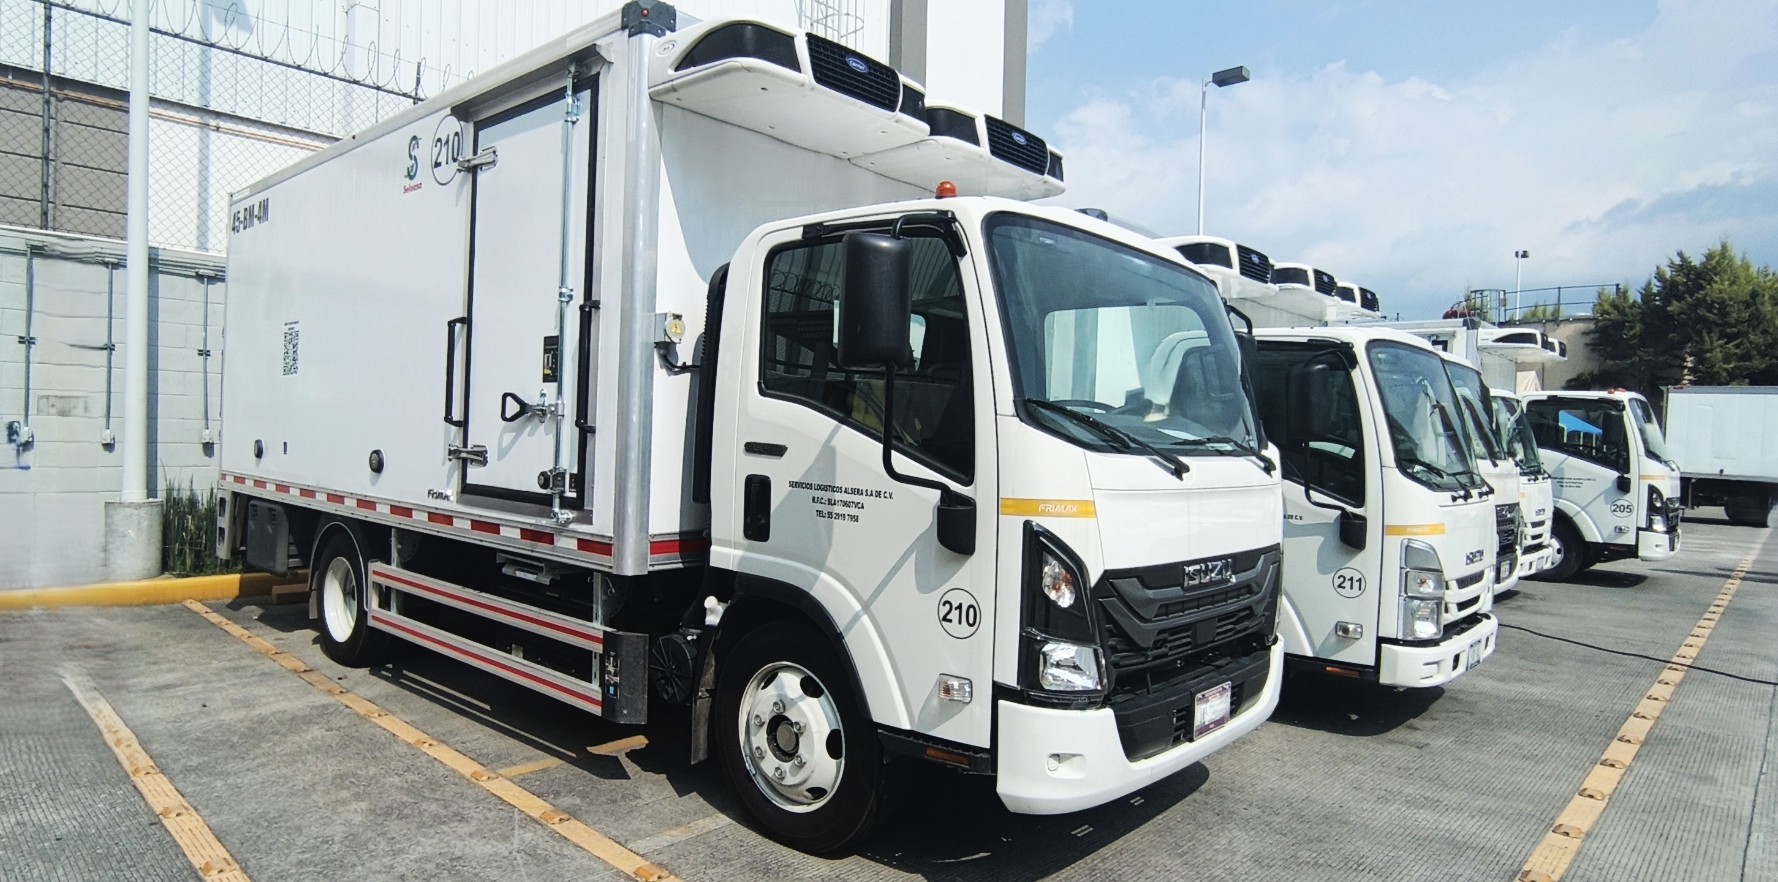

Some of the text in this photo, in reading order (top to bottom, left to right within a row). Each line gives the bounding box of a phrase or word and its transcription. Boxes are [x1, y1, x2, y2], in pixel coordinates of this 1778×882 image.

[433, 131, 460, 168] 210
[788, 480, 813, 490] SERVICIOS
[813, 483, 843, 494] LOGISTICOS
[843, 487, 864, 496] ALSERA
[874, 490, 882, 499] DE
[816, 509, 827, 518] TEL:
[1038, 503, 1077, 513] FRIMAX
[1612, 503, 1632, 513] 205
[1183, 558, 1232, 587] ISUZU
[1337, 574, 1362, 591] 211
[941, 600, 977, 627] 210
